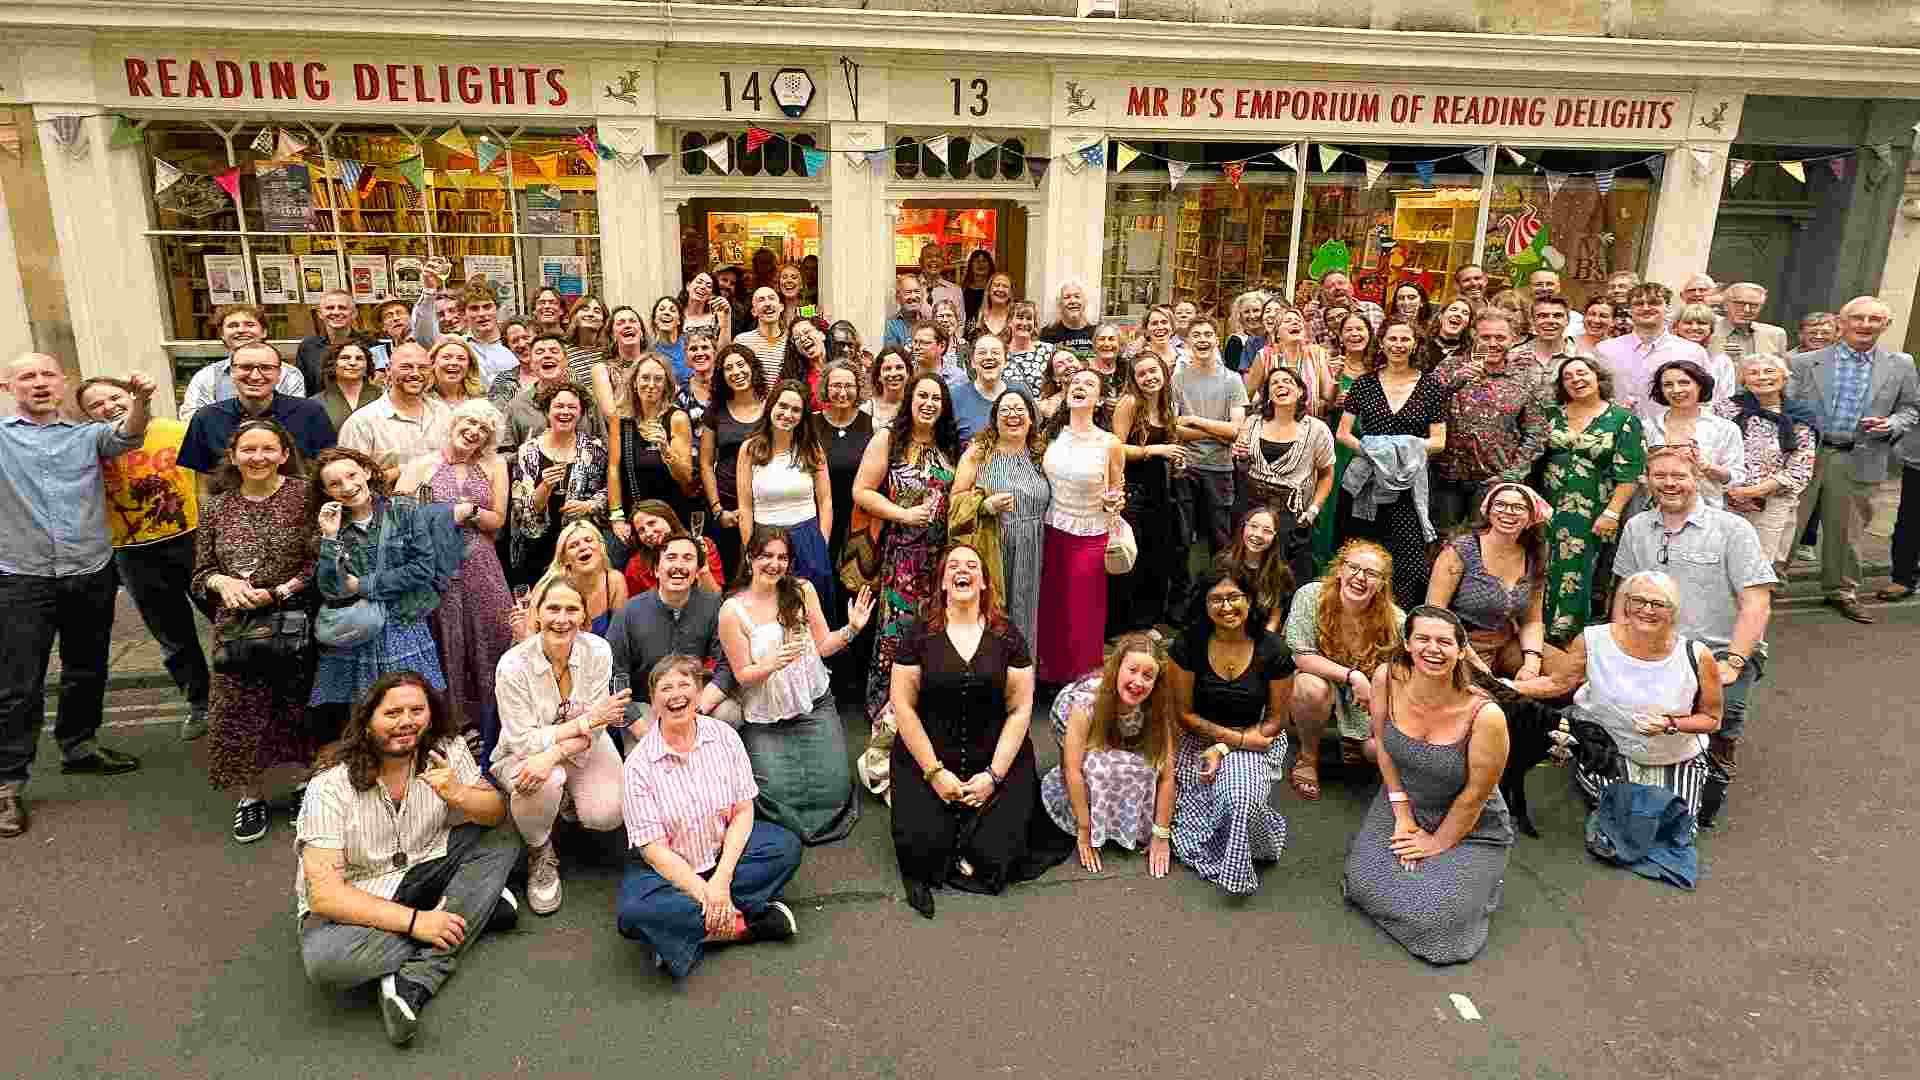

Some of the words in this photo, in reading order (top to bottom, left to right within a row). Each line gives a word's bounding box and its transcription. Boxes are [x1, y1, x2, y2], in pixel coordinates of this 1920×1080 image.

[124, 58, 330, 100] READING
[353, 63, 568, 106] DELIGHTS
[719, 71, 762, 111] 14
[950, 78, 989, 116] 13
[1127, 86, 1168, 117] MR
[1180, 87, 1224, 119] B'S
[1234, 89, 1380, 122] EMPORIUM
[1390, 94, 1425, 123] OF
[1432, 95, 1546, 127] READING
[1554, 98, 1674, 129] DELIGHTS
